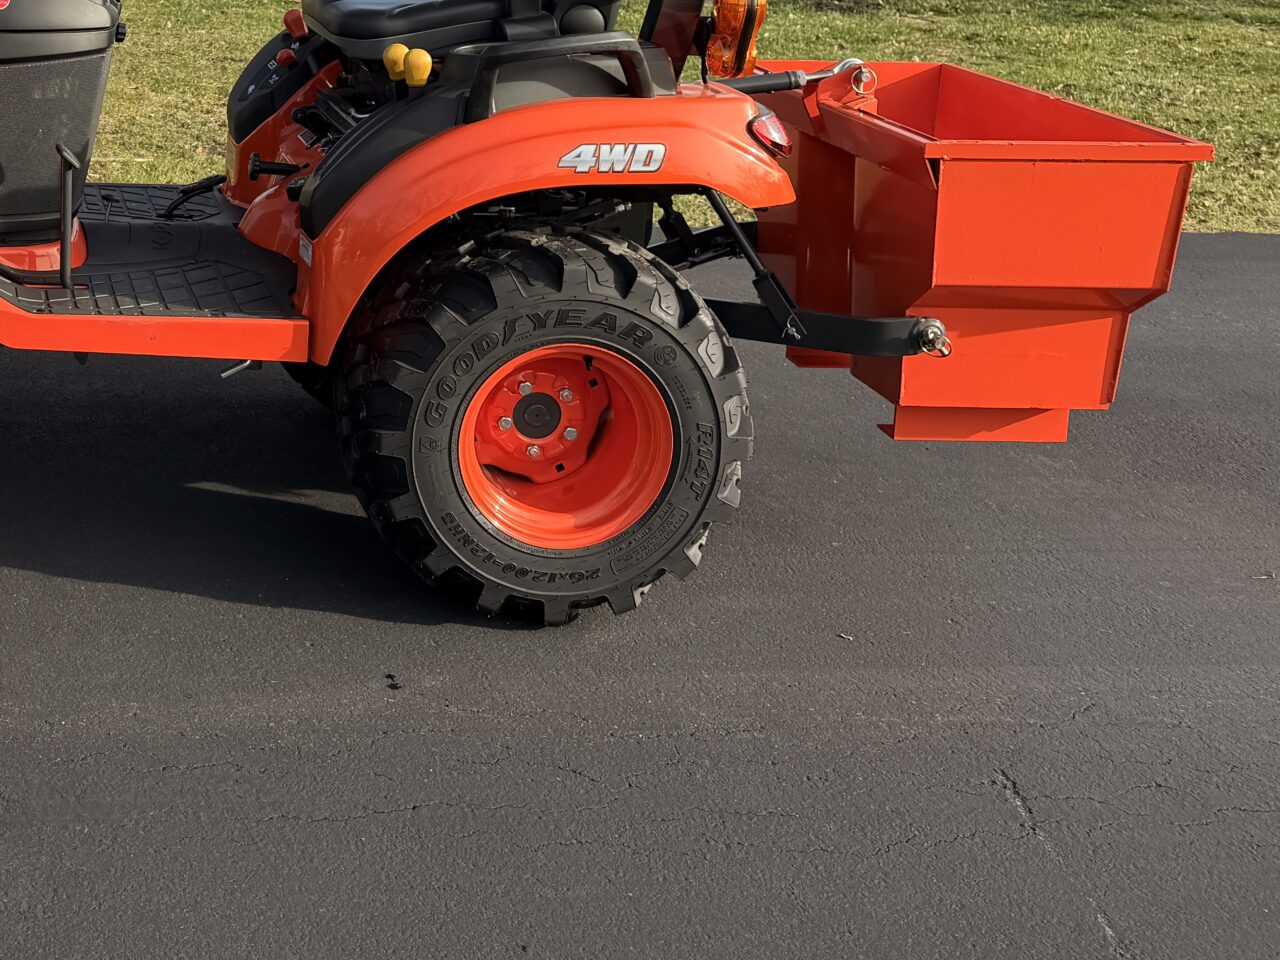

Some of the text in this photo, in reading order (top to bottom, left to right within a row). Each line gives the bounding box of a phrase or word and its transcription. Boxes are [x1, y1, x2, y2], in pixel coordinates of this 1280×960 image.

[557, 143, 666, 173] 4WD
[424, 308, 655, 428] GOODYEAR
[690, 422, 714, 502] R14T
